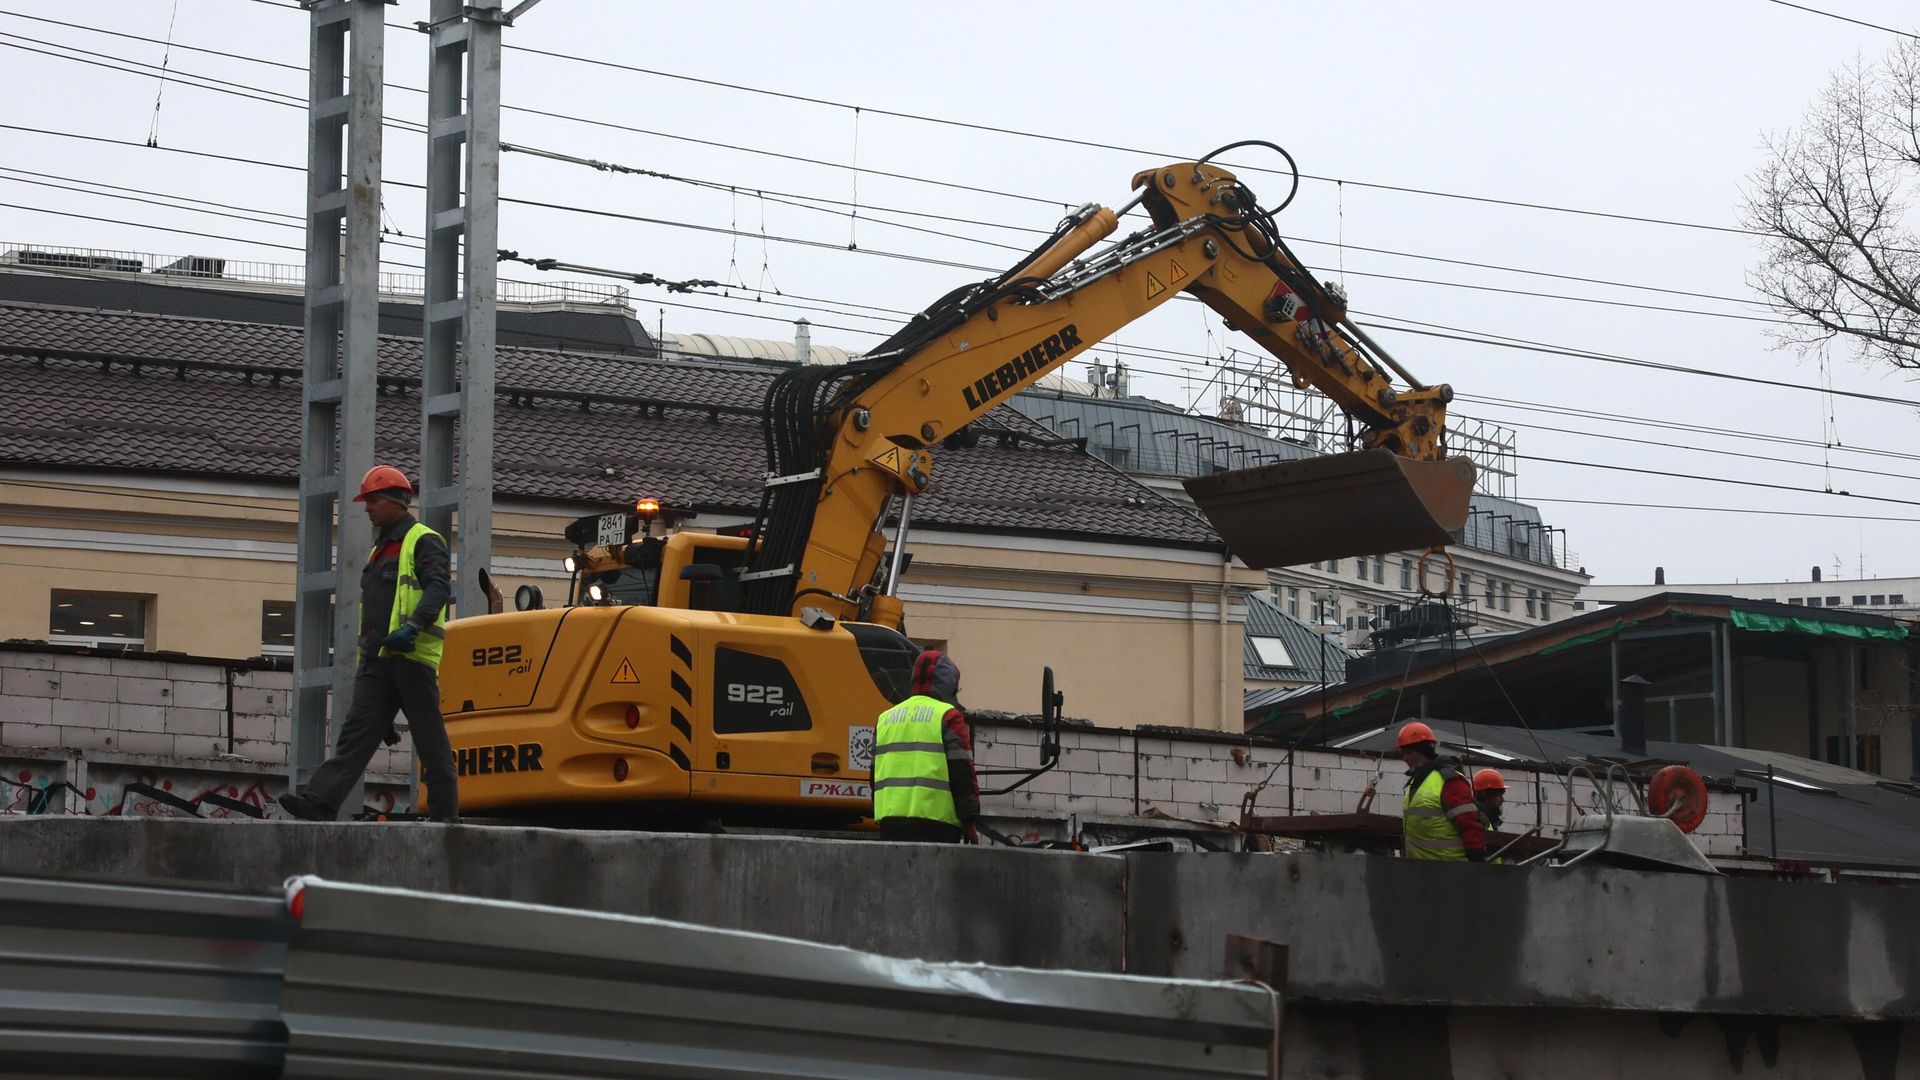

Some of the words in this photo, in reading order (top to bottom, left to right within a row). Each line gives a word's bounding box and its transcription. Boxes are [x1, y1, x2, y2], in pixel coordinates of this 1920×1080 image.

[962, 324, 1083, 411] LIEBHERR
[601, 515, 623, 530] 2841
[614, 532, 622, 543] 77
[472, 645, 522, 667] 922
[509, 658, 532, 676] rail
[728, 683, 783, 705] 922
[770, 702, 794, 717] rail
[421, 742, 543, 780] HERR
[808, 783, 871, 797] РЖДС
